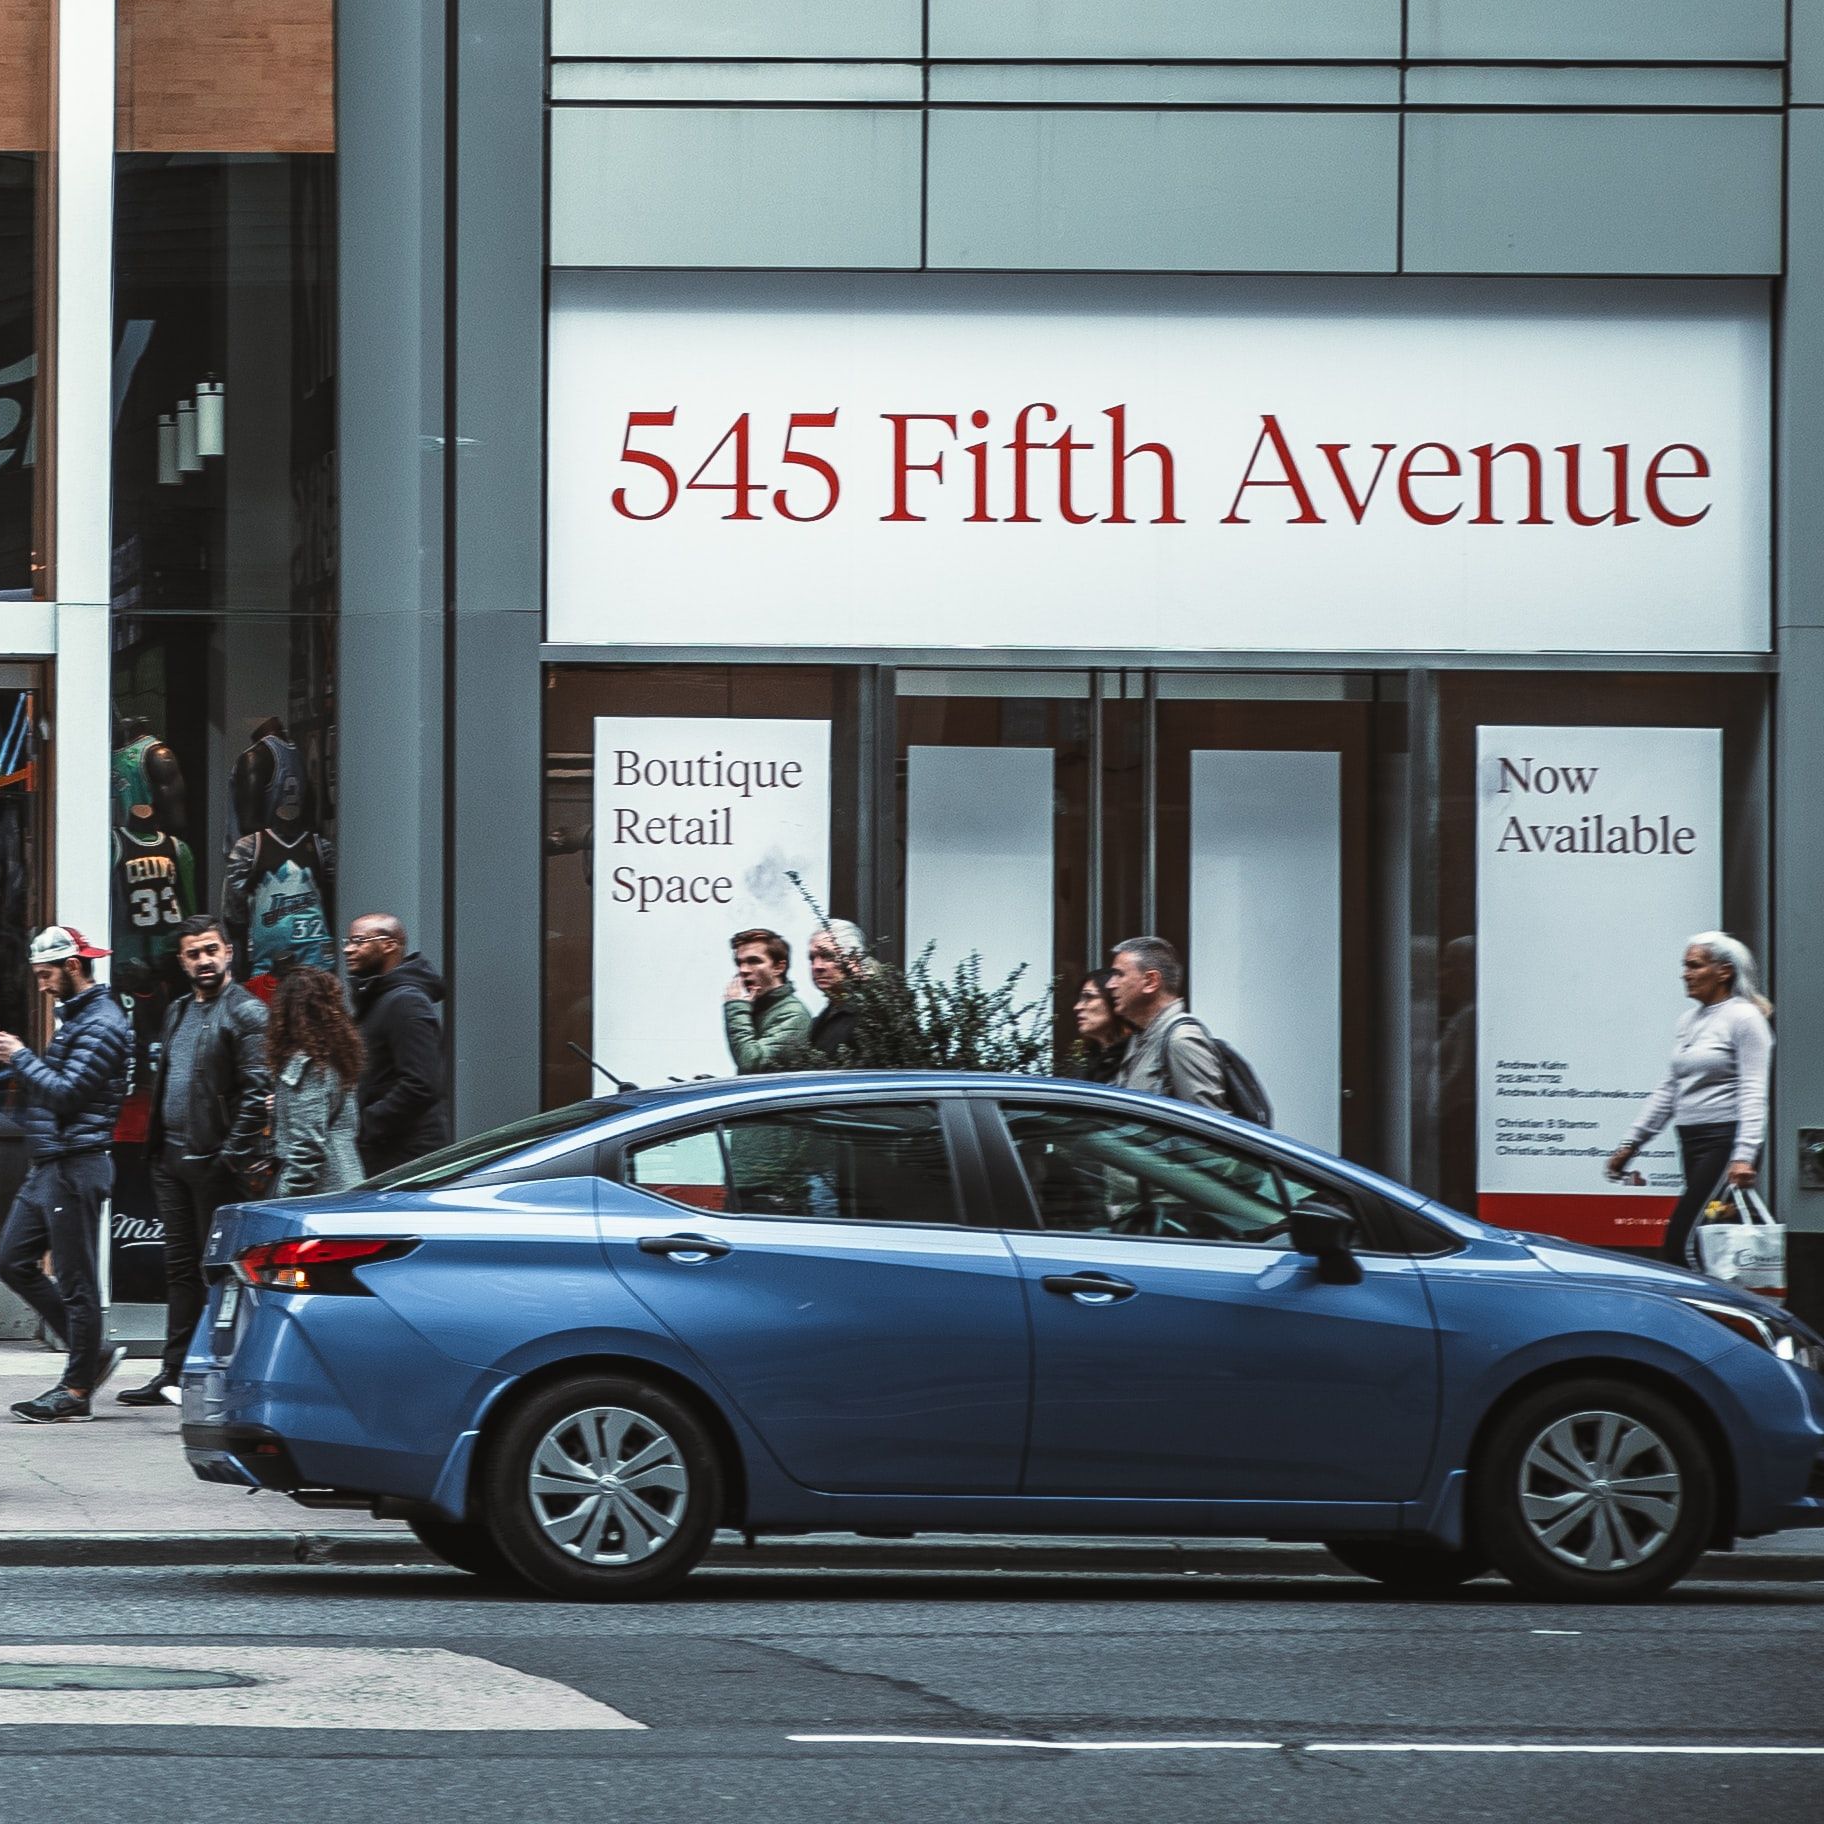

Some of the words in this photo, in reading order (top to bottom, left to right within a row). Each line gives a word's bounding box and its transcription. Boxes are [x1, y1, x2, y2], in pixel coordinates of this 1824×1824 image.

[612, 405, 841, 522] 545
[879, 402, 1187, 524] Fifth
[1218, 413, 1713, 527] Avenue
[612, 749, 803, 798] Boutique
[1496, 757, 1600, 795] Now
[612, 806, 734, 846] Retail
[1495, 813, 1698, 856] Available
[128, 886, 183, 927] 33
[611, 866, 734, 913] Space
[291, 919, 325, 939] 32
